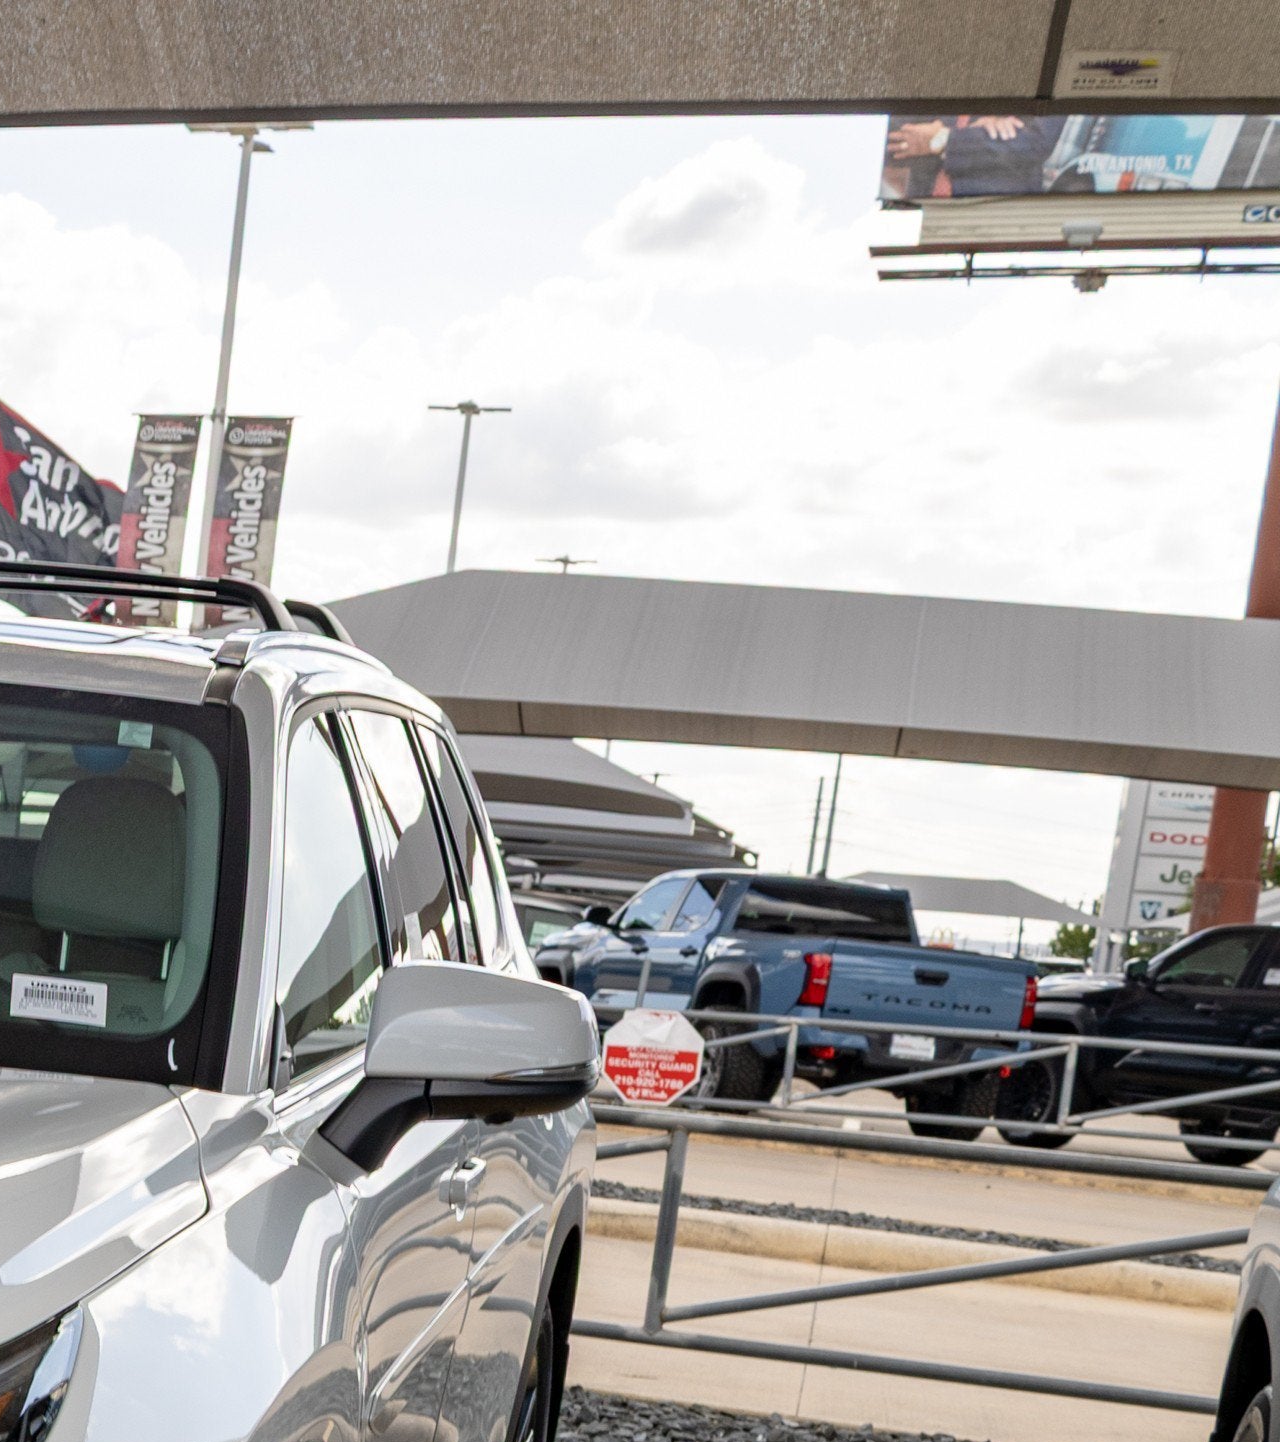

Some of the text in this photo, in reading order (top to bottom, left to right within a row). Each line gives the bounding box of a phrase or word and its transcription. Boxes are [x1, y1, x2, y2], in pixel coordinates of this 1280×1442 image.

[1174, 154, 1194, 170] TX
[136, 461, 177, 559] Vehicles
[226, 465, 267, 564] Vehicles
[1158, 790, 1214, 799] CHRY
[1149, 832, 1208, 845] DOD
[1159, 863, 1191, 885] Je
[861, 993, 992, 1014] TACOMA
[608, 1057, 695, 1073] SECURITY GUARD
